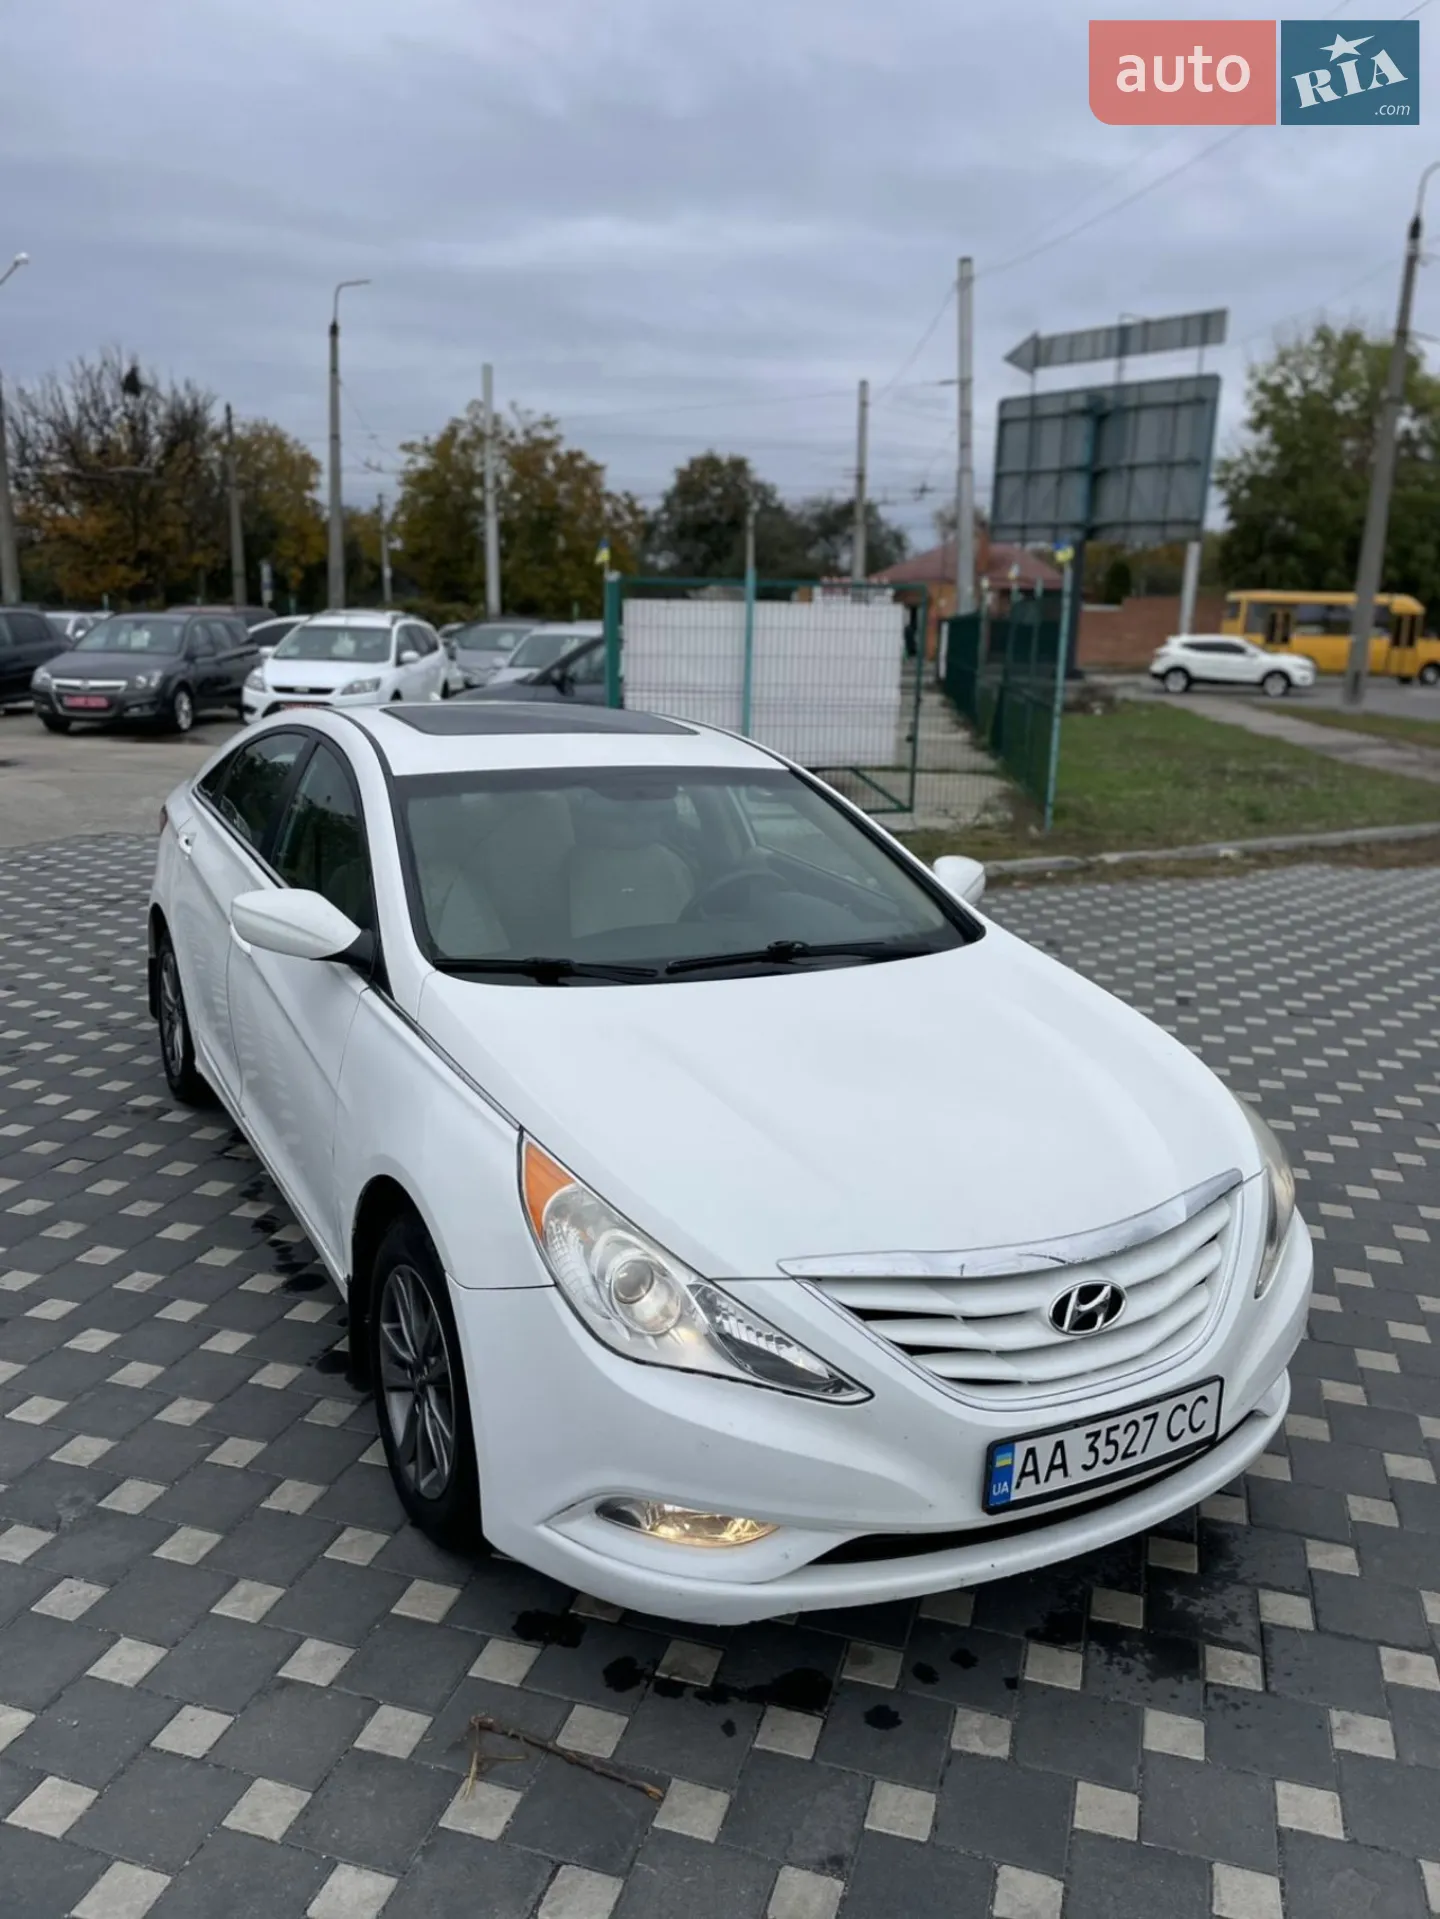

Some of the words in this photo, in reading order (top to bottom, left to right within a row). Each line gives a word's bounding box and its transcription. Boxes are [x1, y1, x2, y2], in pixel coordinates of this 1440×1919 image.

[1015, 1440, 1069, 1490] AA
[1081, 1412, 1159, 1471] 3527
[1166, 1396, 1208, 1442] CC
[992, 1481, 1009, 1496] UA
